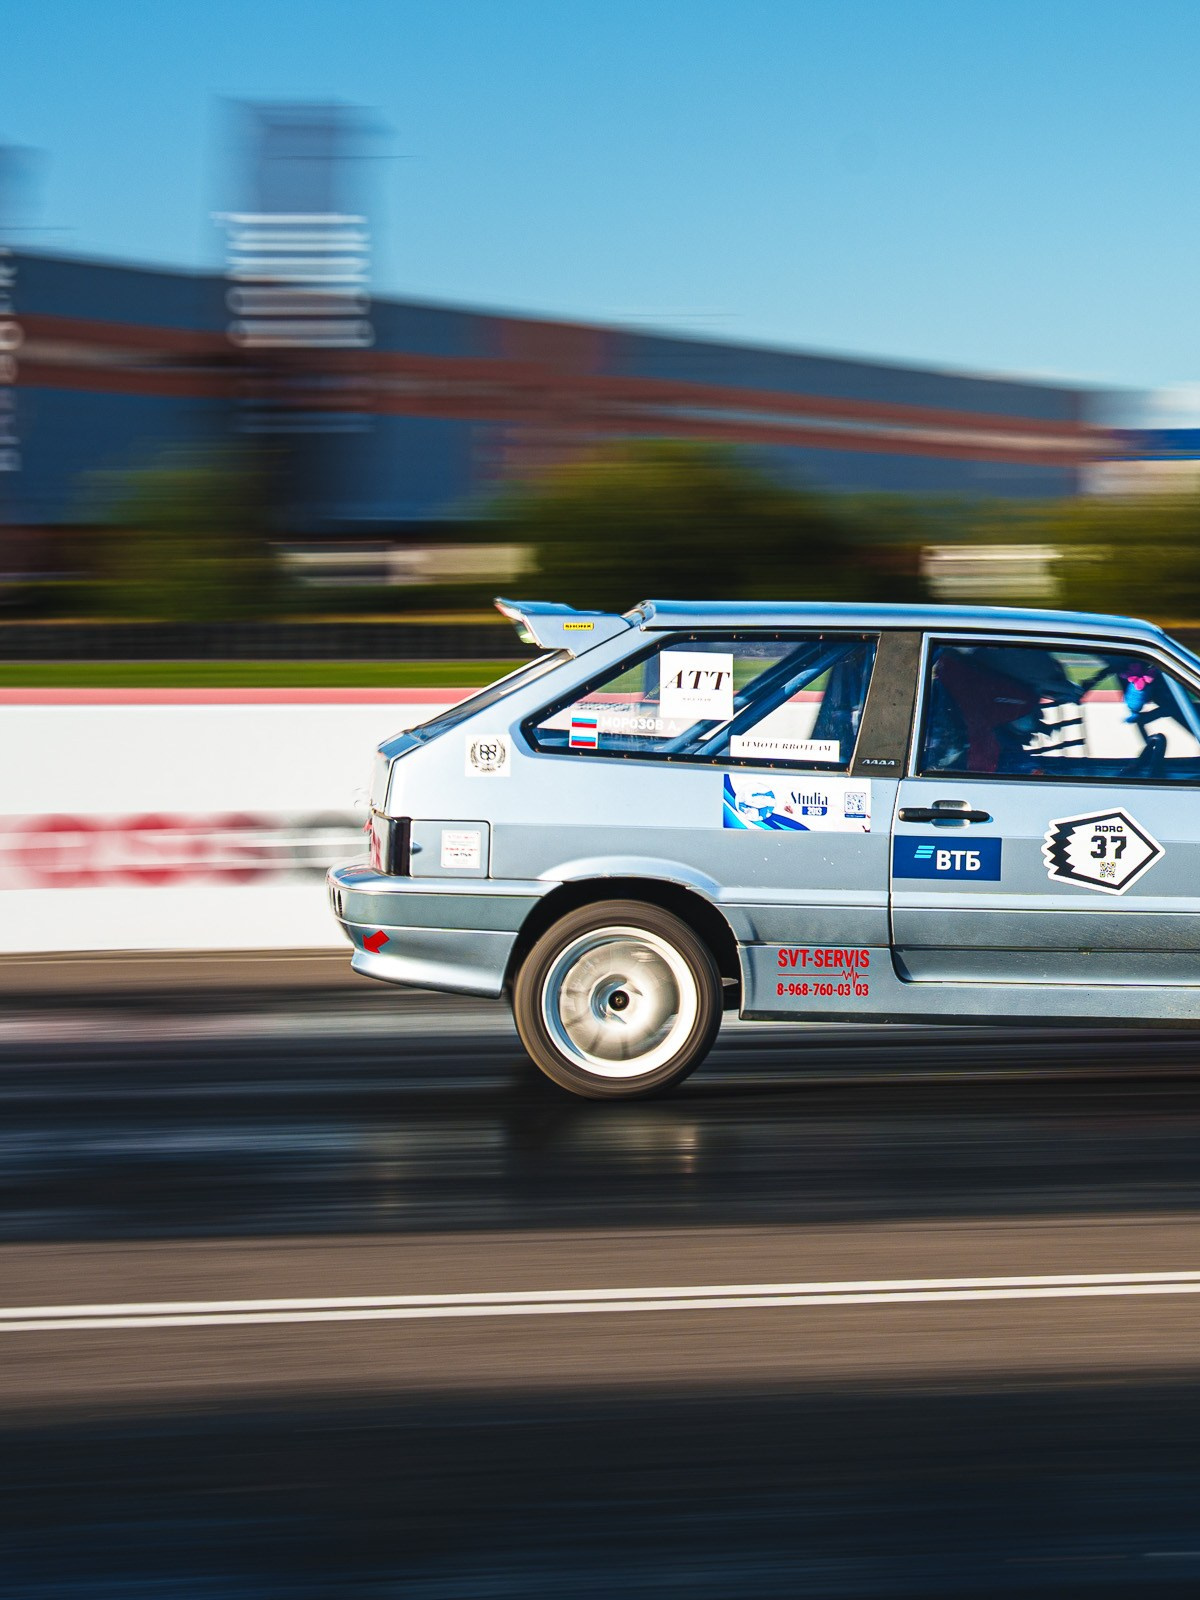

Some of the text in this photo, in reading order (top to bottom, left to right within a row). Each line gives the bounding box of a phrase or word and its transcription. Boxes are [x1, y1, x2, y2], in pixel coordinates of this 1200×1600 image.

[664, 669, 731, 691] ATT
[790, 791, 828, 806] Studia
[1095, 825, 1124, 833] RDRC
[1090, 835, 1127, 859] 37
[936, 849, 981, 871] ВТБ
[777, 948, 871, 968] SVT-SERVIS
